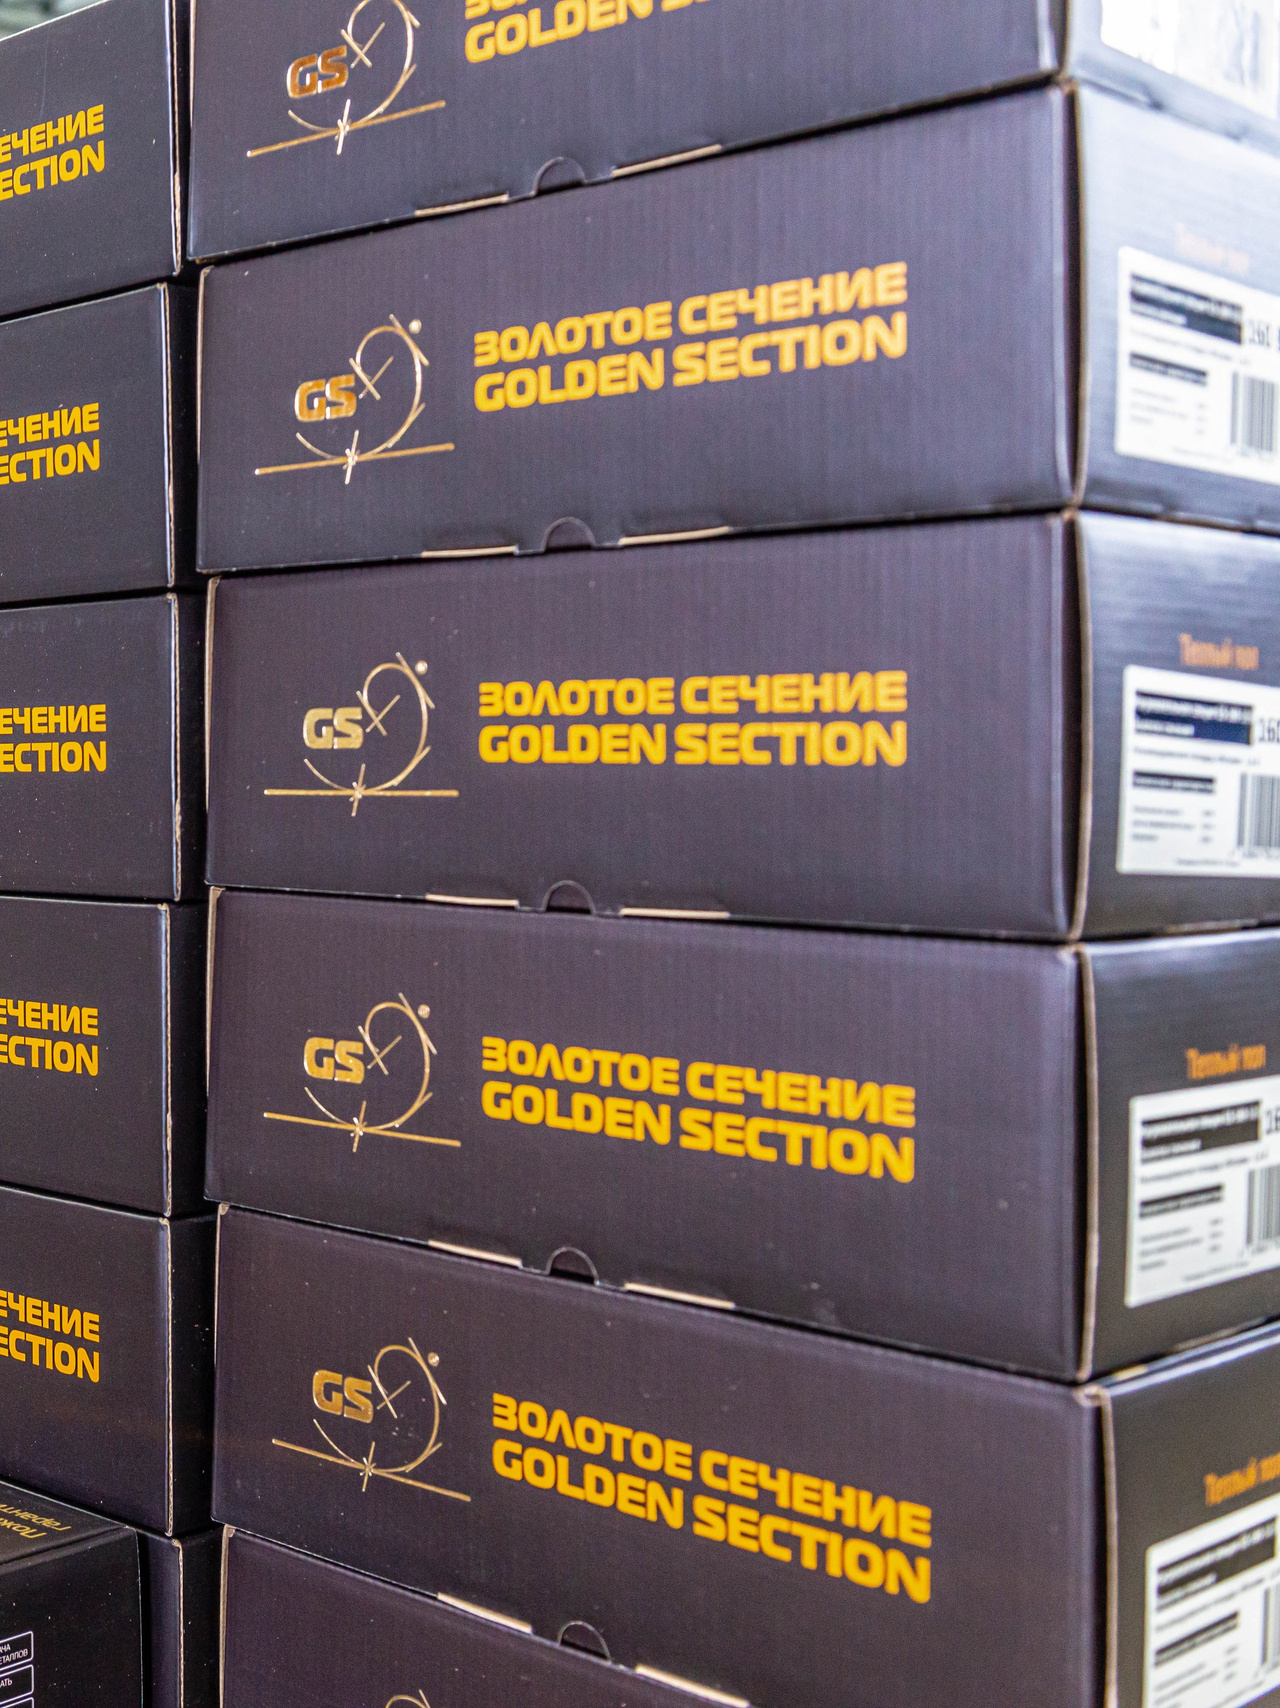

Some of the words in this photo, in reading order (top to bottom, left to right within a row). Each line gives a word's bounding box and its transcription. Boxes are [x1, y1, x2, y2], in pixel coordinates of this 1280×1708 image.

[286, 45, 348, 98] GS
[473, 300, 673, 367] ЗОЛОТОЕ
[678, 262, 908, 335] СЕЧЕНИЕ
[473, 347, 665, 413] GOLDEN
[672, 311, 907, 387] SECTION
[295, 374, 357, 421] GS
[478, 676, 676, 717] ЗОЛОТОЕ
[680, 670, 908, 715] СЕЧЕНИЕ
[302, 707, 364, 749] GS
[478, 722, 667, 765] GOLDEN
[673, 720, 908, 767] SECTION
[304, 1037, 365, 1084] GS
[481, 1035, 681, 1097] ЗОЛОТОЕ
[685, 1061, 916, 1129] СЕЧЕНИЕ
[481, 1080, 672, 1146] GOLDEN
[678, 1107, 915, 1184] SECTION
[312, 1369, 374, 1423] GS
[492, 1392, 693, 1482] ЗОЛОТОЕ
[699, 1449, 932, 1549] СЕЧЕНИЕ
[492, 1438, 684, 1530] GOLDEN
[692, 1494, 931, 1604] SECTION
